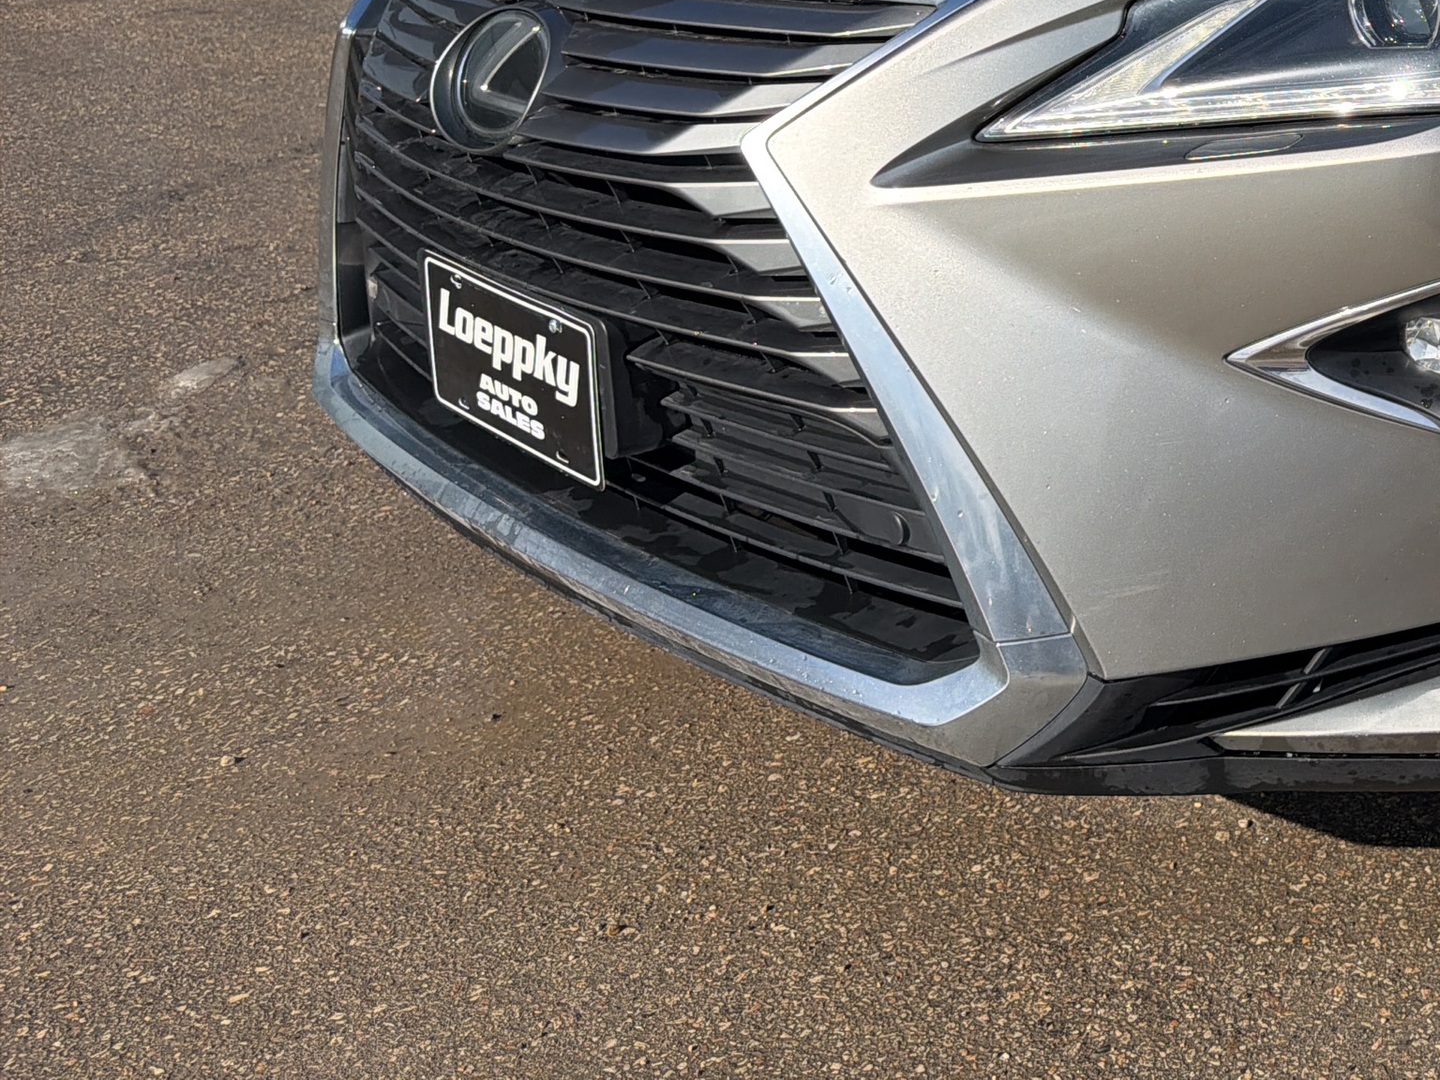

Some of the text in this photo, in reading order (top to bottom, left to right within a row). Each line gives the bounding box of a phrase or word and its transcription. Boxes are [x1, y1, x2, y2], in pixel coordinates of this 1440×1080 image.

[439, 288, 580, 407] Loeppky
[476, 391, 545, 440] SALES
[479, 373, 538, 416] AUTO
